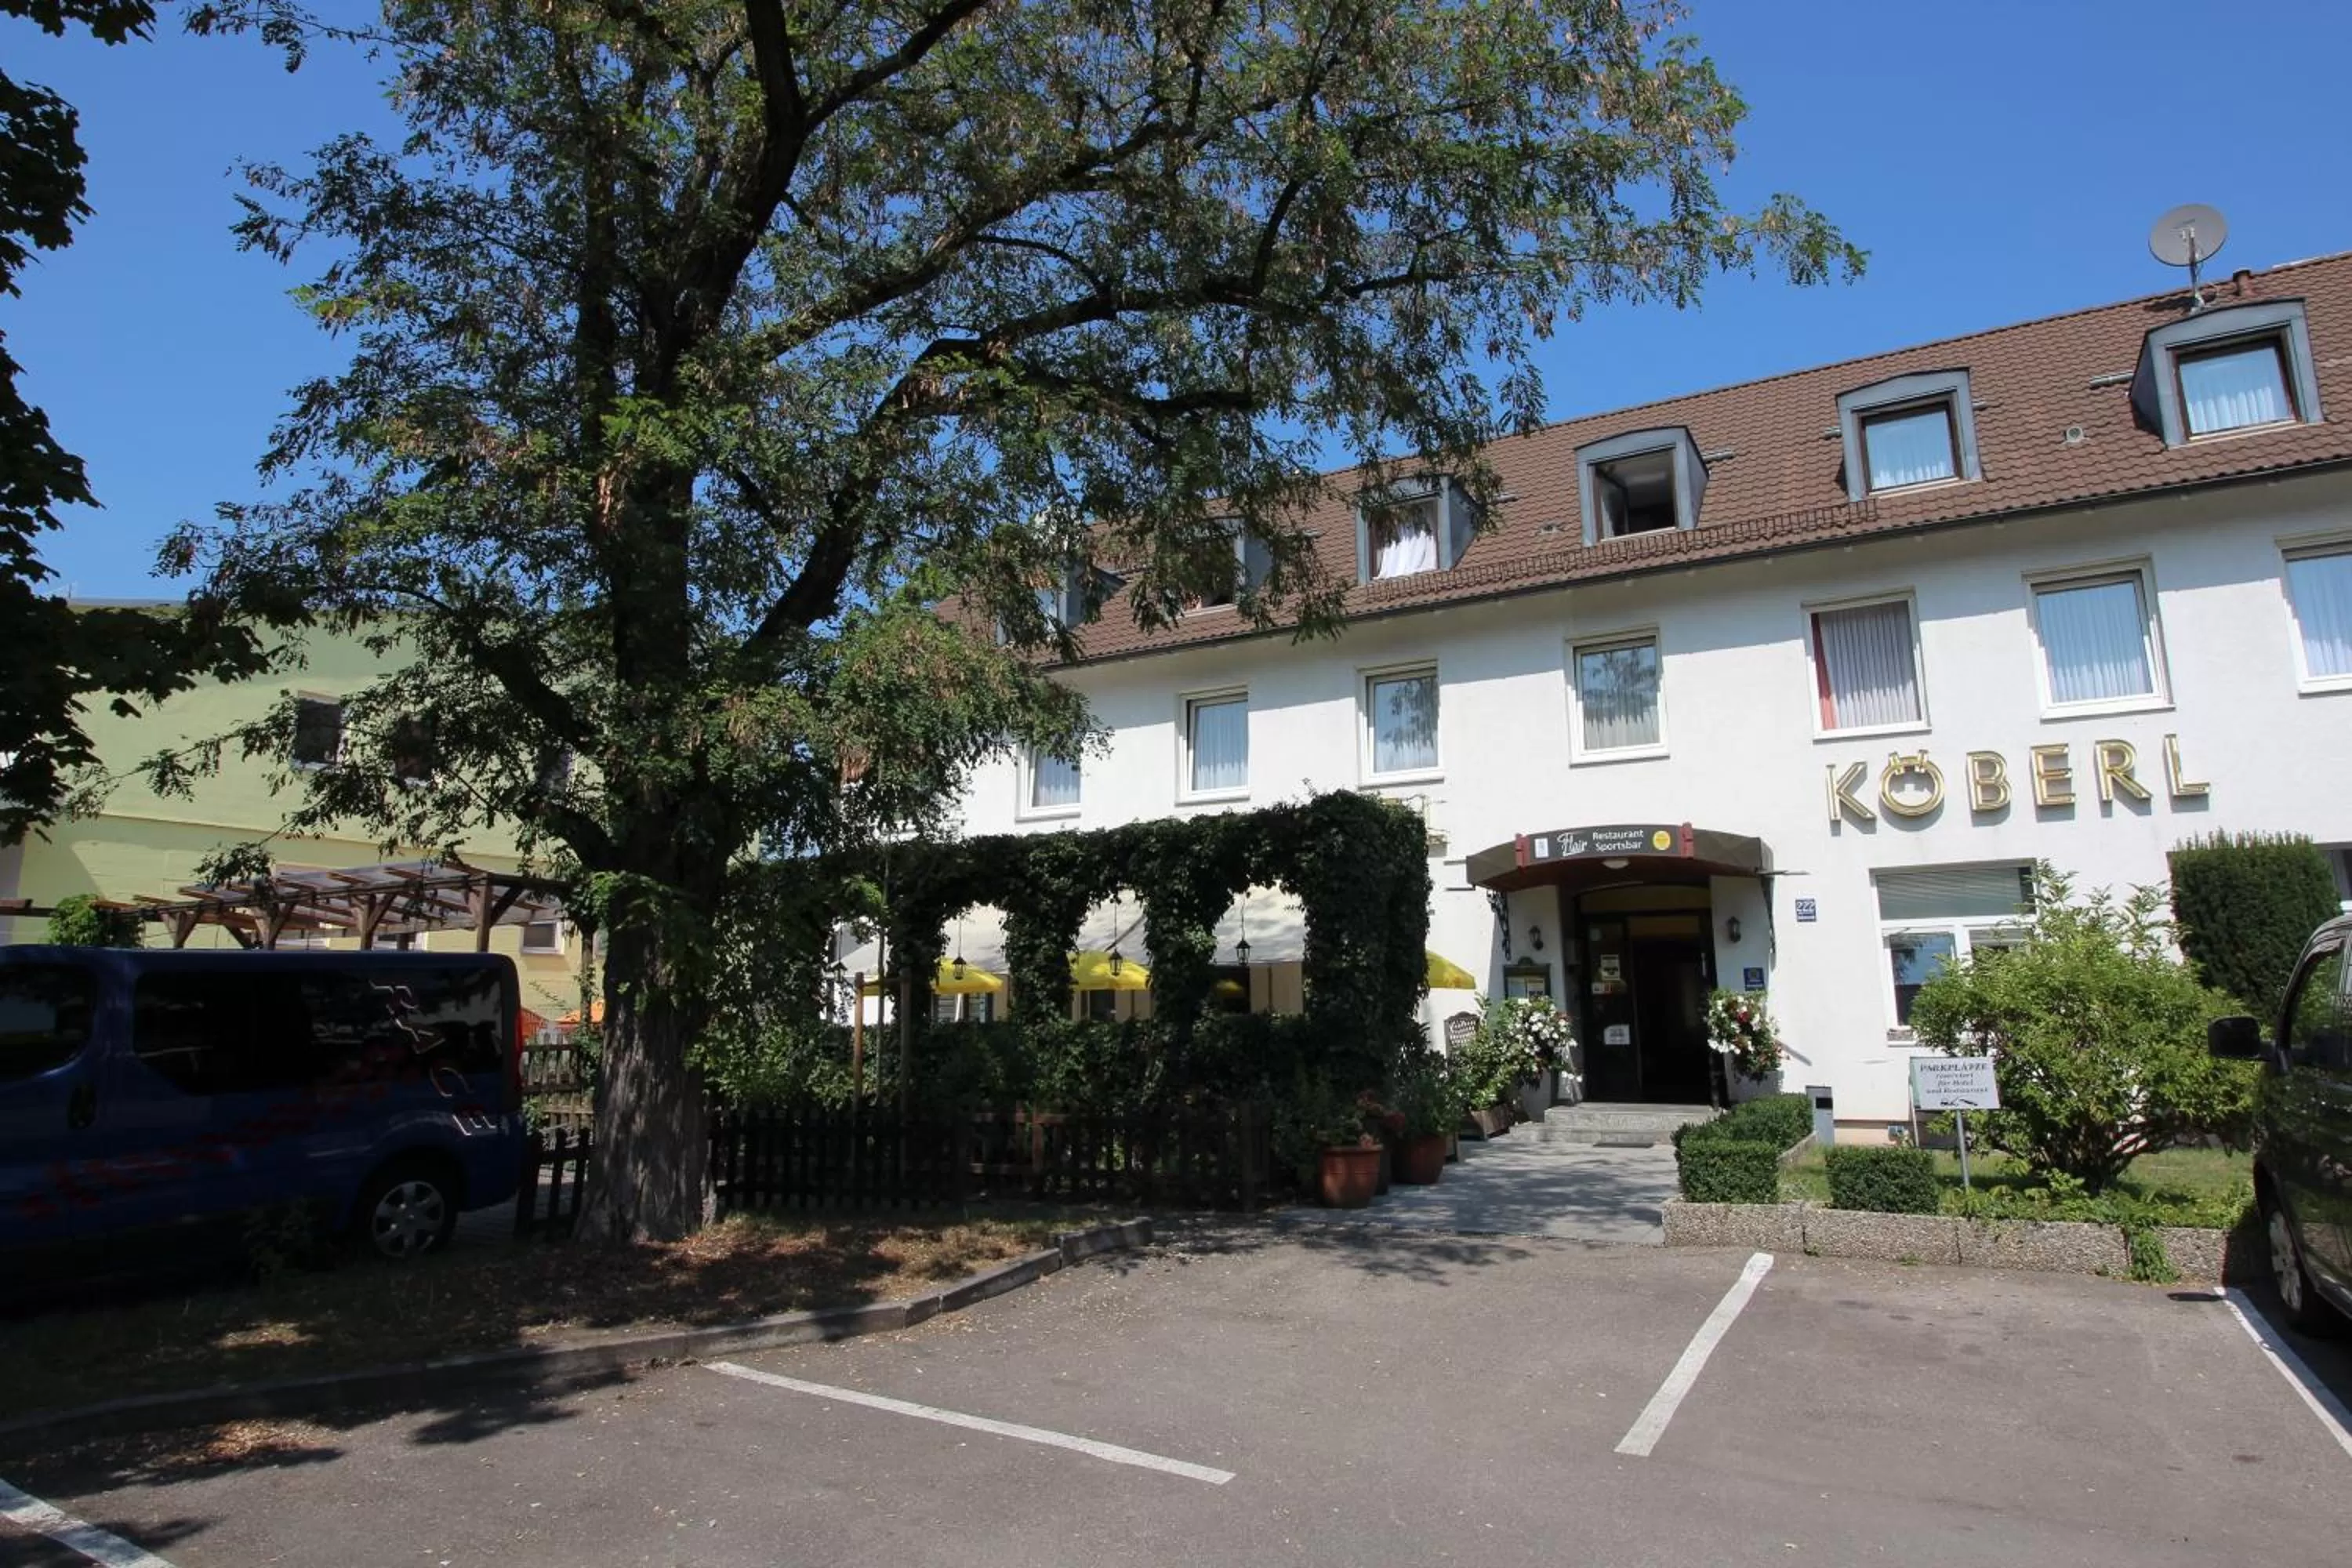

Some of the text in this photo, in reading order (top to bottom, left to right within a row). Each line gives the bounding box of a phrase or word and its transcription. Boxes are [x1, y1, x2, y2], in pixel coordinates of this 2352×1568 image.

[1826, 734, 2210, 822] KÖBERL
[1592, 829, 1644, 841] Restaurant
[1595, 840, 1642, 853] Sportsbar
